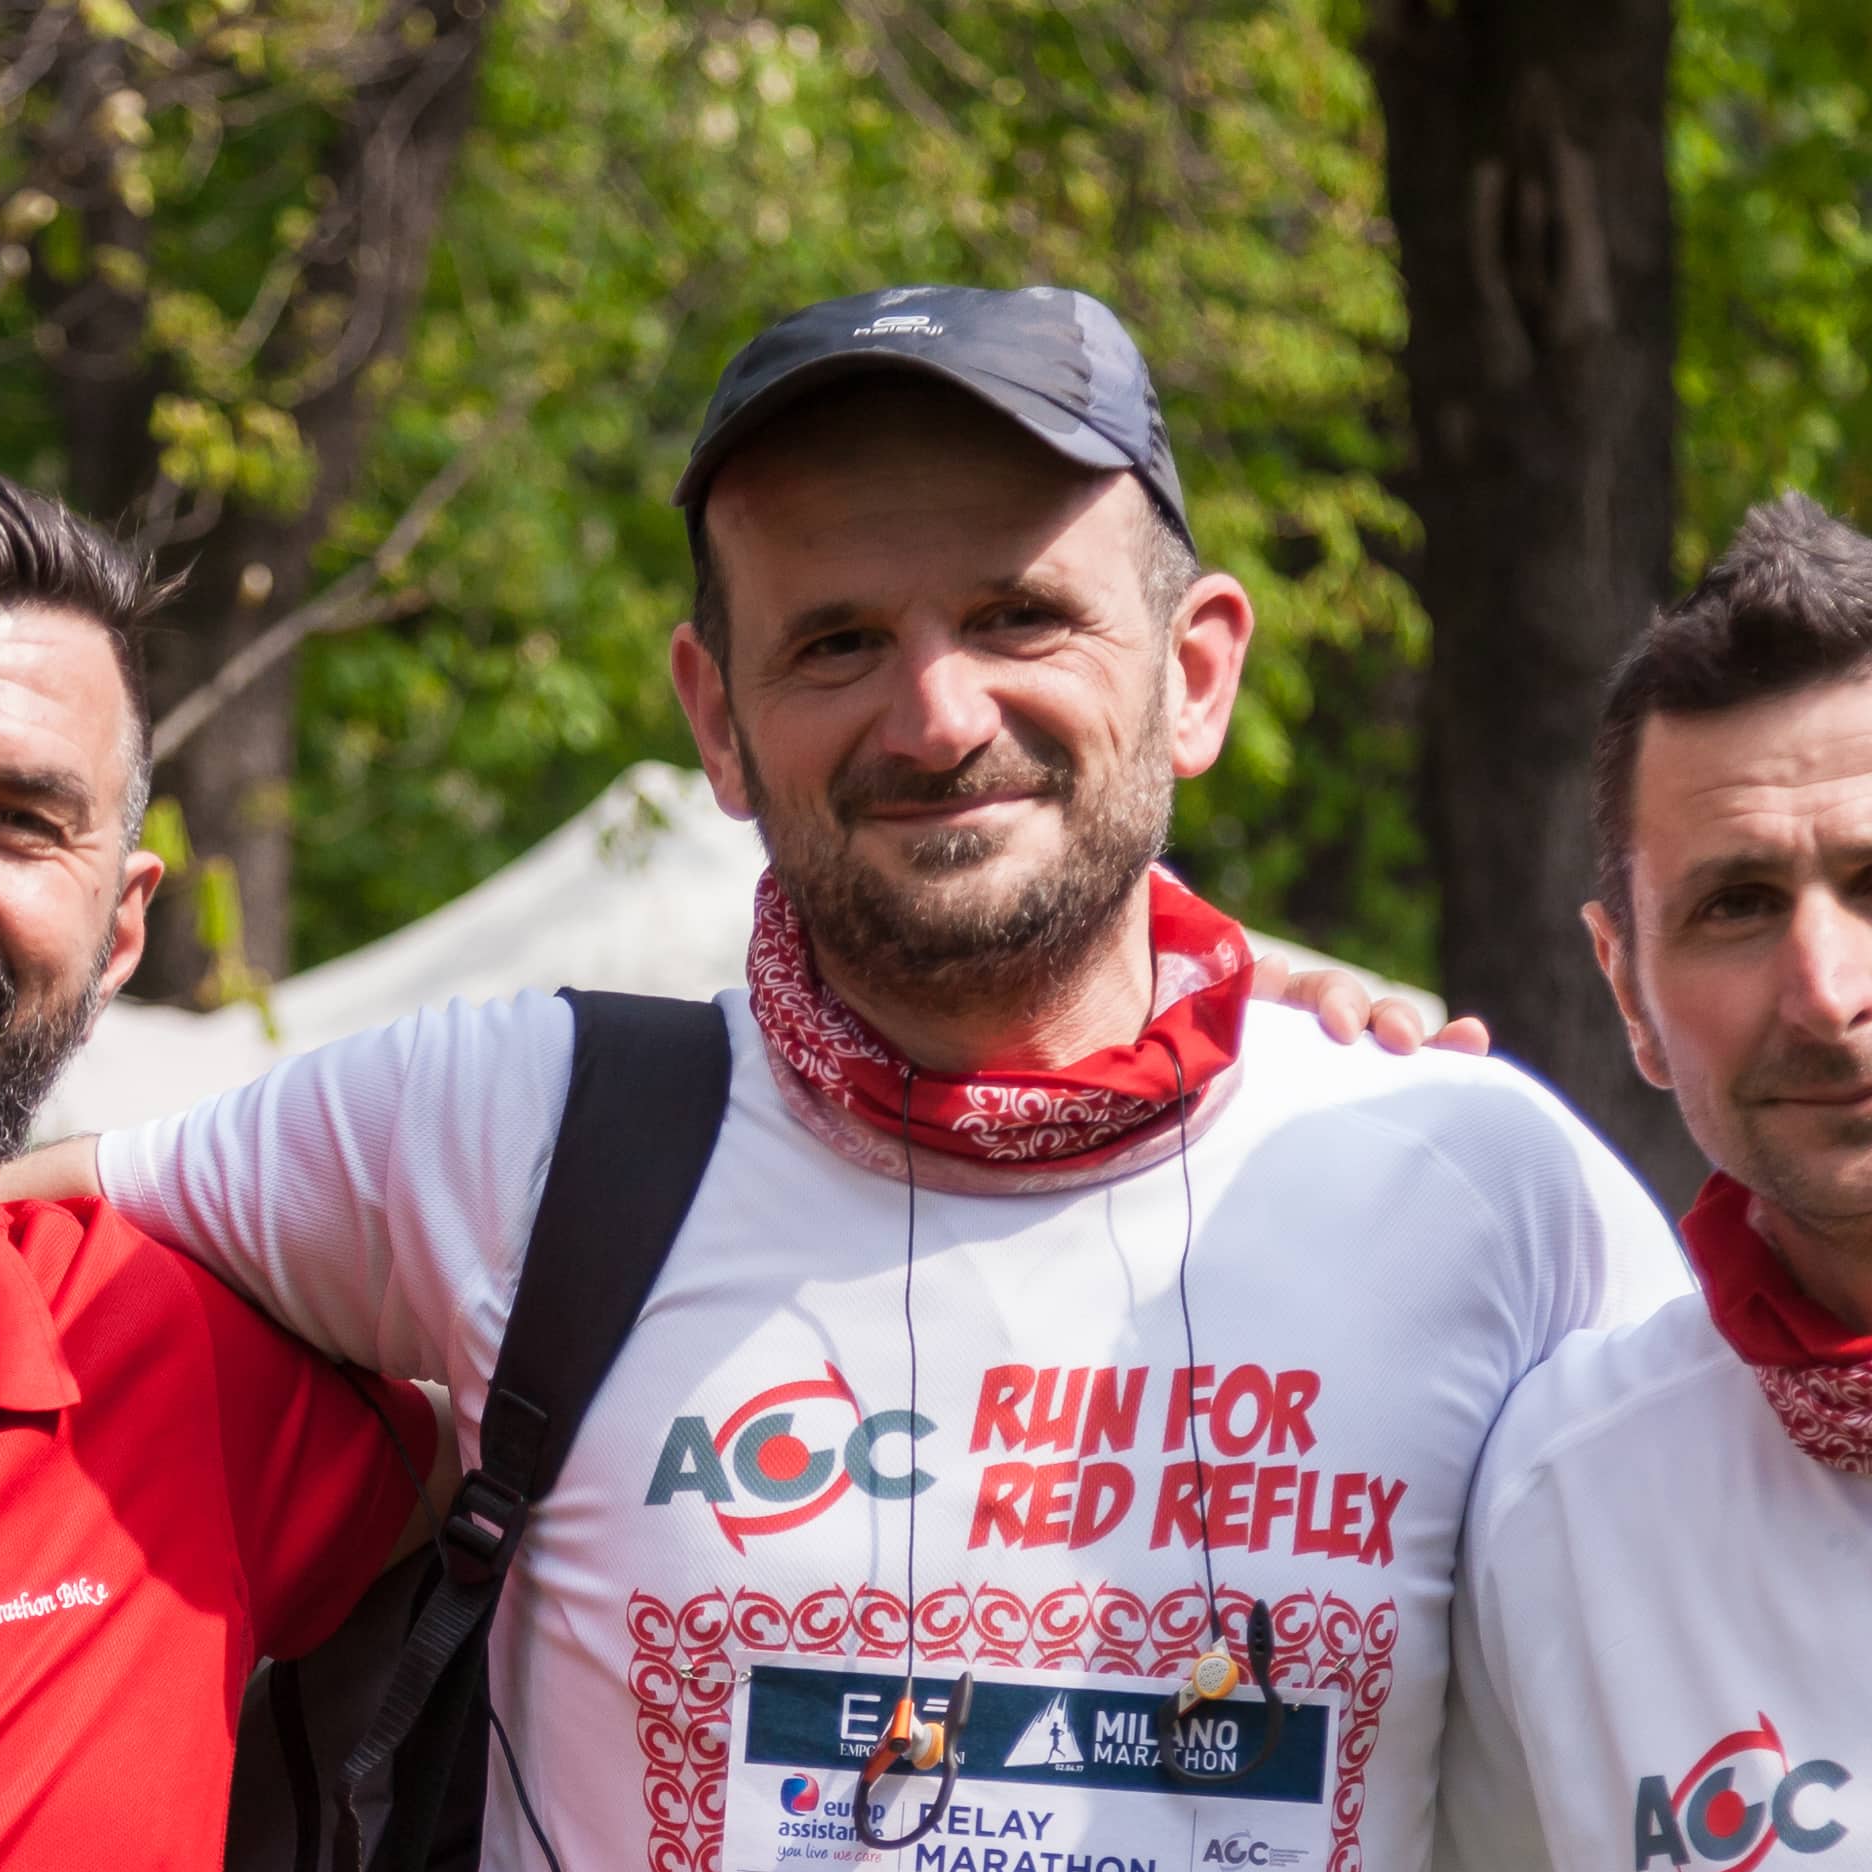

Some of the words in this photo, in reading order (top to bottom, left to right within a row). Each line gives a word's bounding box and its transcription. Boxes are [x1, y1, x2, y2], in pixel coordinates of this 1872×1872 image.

[969, 1364, 1149, 1459] RUN
[1162, 1363, 1321, 1458] FOR
[967, 1461, 1135, 1552] RED
[1149, 1461, 1409, 1569] REFLEX
[56, 1578, 109, 1609] Bike
[824, 1801, 886, 1825] eup
[919, 1803, 1056, 1841] RELAY
[778, 1818, 884, 1843] assistane
[776, 1846, 802, 1862] you
[806, 1843, 828, 1860] live
[833, 1851, 852, 1860] we
[855, 1851, 881, 1864] care
